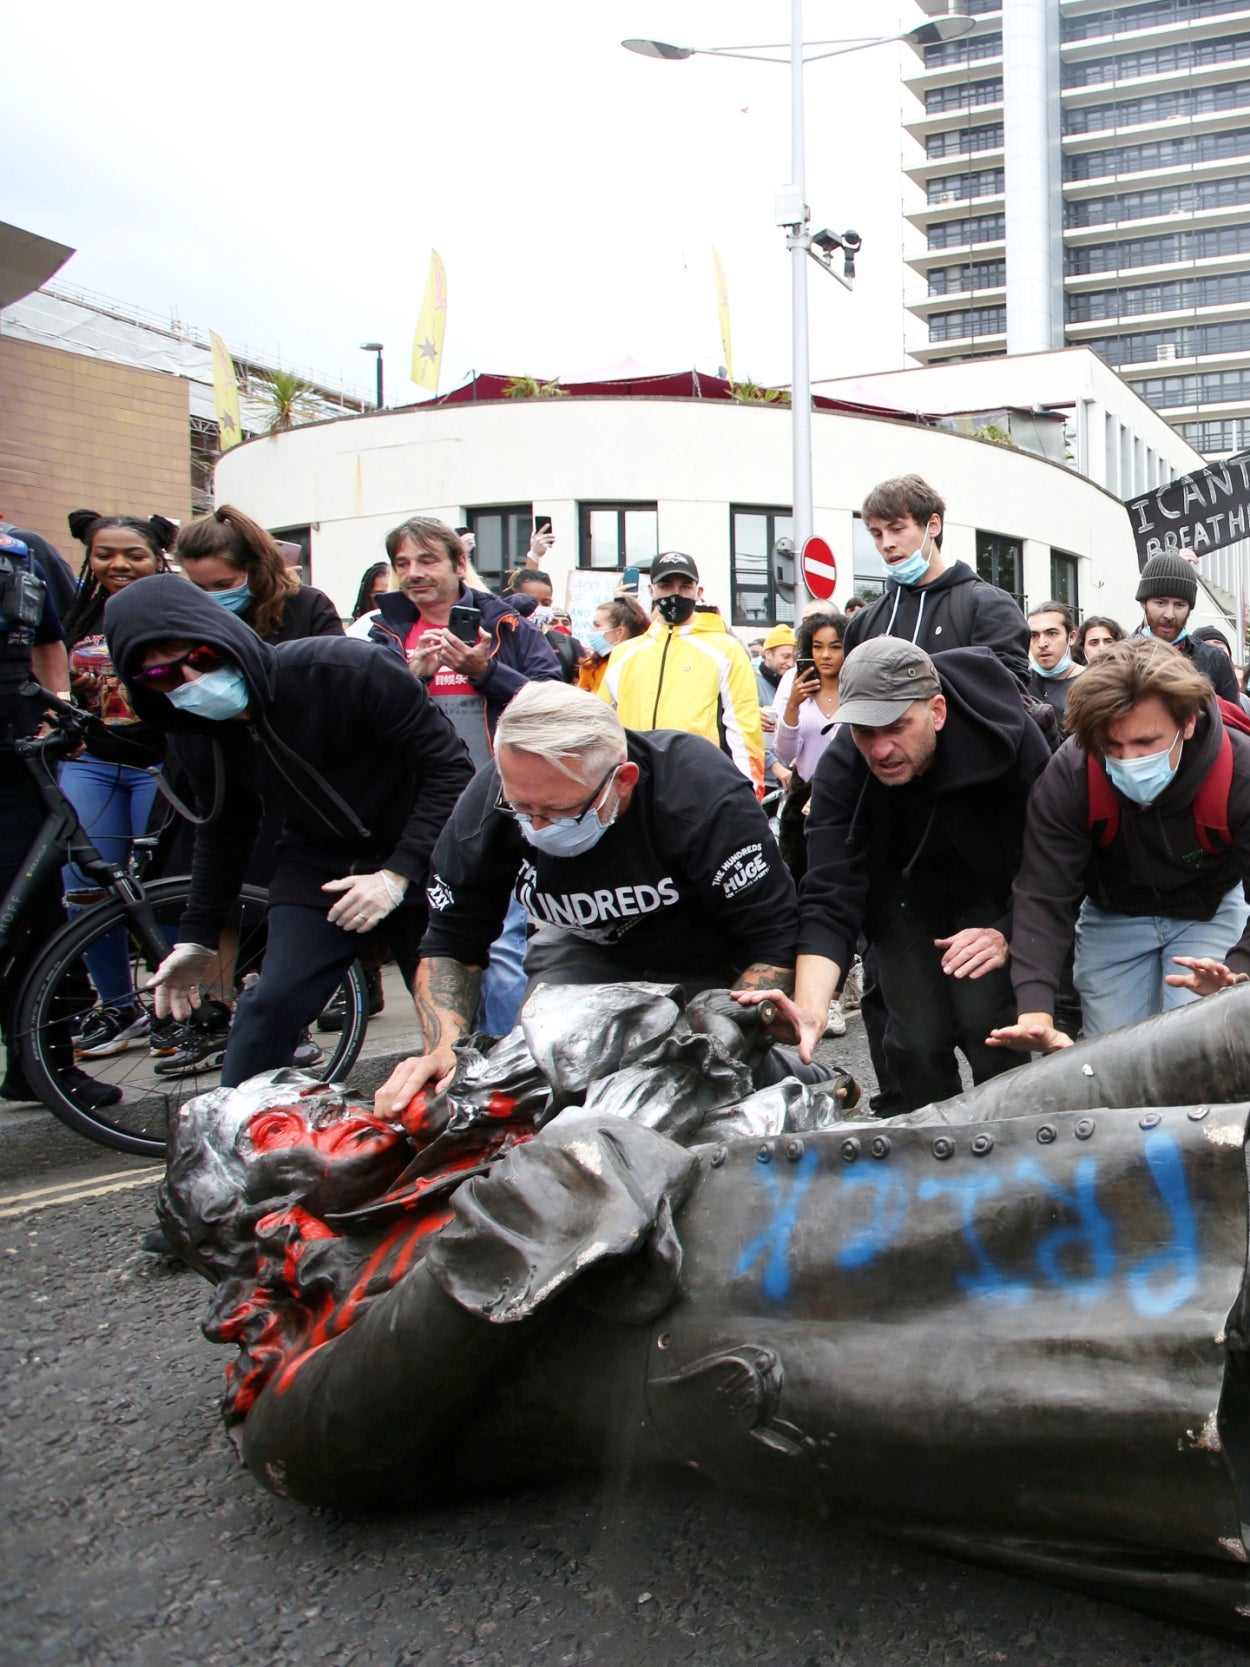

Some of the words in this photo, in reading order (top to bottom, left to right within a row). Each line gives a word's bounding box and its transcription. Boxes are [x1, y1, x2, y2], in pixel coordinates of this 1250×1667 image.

[1131, 499, 1155, 534] I
[712, 870, 725, 886] THE
[721, 843, 762, 871] HUNDREDS
[723, 852, 767, 893] HUGE
[734, 861, 743, 871] IS
